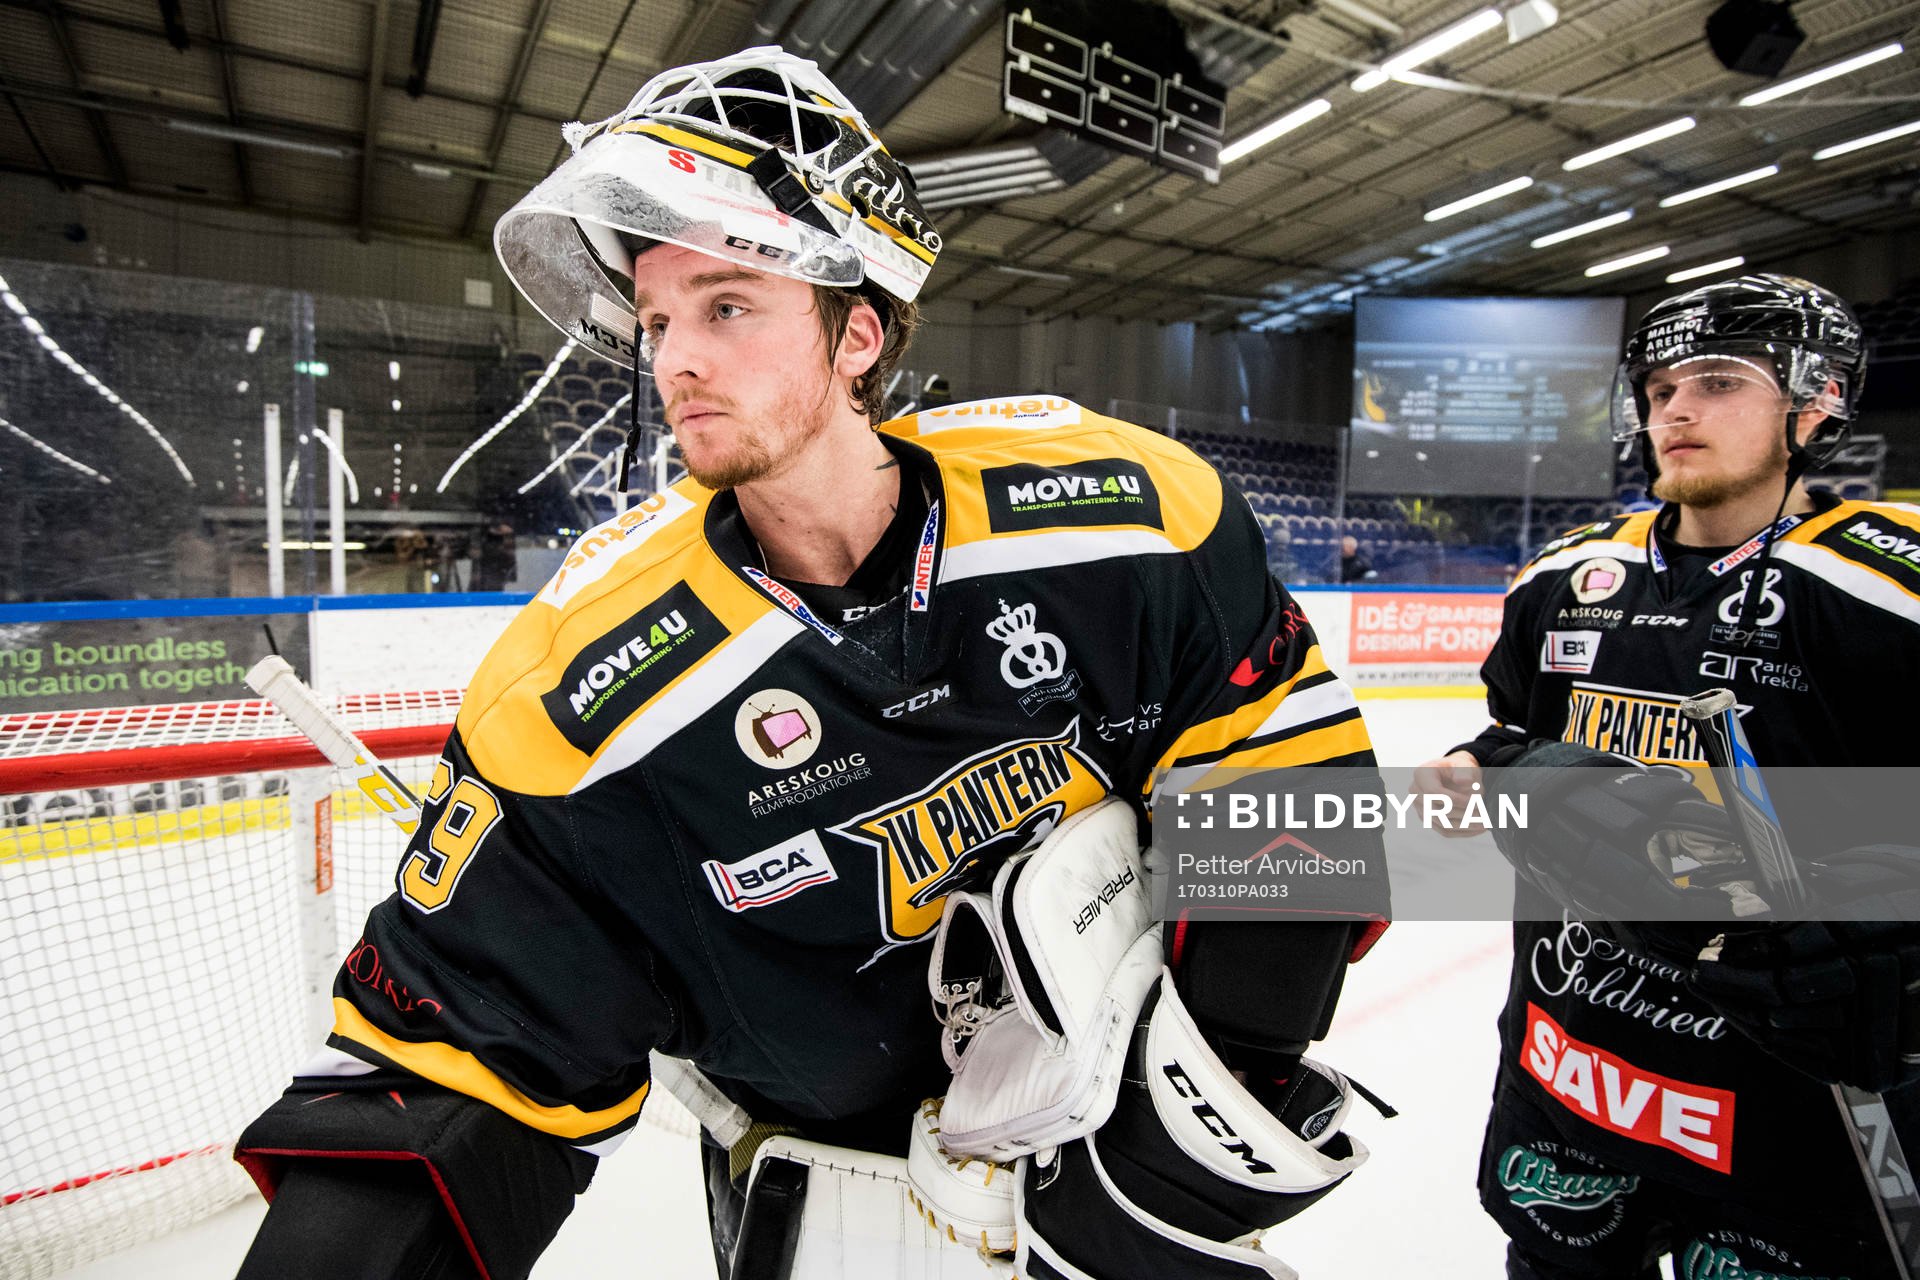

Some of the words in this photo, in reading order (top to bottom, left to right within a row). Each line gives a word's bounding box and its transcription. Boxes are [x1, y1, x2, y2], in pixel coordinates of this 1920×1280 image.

[1645, 332, 1695, 351] ARENA
[1008, 474, 1141, 506] MOVE4U
[1012, 500, 1066, 513] TRANSPORTER
[1071, 496, 1119, 507] MONTERING
[915, 506, 939, 590] INTERSPORT
[758, 577, 839, 640] INTERSPORT
[1356, 601, 1399, 631] IDÉ
[1630, 614, 1689, 628] CCM
[53, 636, 227, 666] boundless
[569, 609, 688, 716] MOVE4U
[1356, 634, 1421, 651] DESIGN
[581, 678, 627, 723] TRANSPORTER
[629, 645, 673, 679] MONTERING
[675, 628, 696, 646] FLYTT
[881, 684, 950, 719] CCM
[748, 752, 867, 807] ARESKOUG
[751, 766, 873, 819] FILMPRODUKTIONER
[876, 808, 941, 886] IK
[923, 742, 1073, 866] PANTERN
[734, 850, 813, 890] BCA
[1072, 865, 1136, 936] PREMIER
[1162, 1058, 1278, 1175] CCM
[1536, 1140, 1559, 1154] EST
[1526, 1207, 1551, 1234] BAR
[1566, 1197, 1626, 1248] RESTAURANT
[1749, 1236, 1790, 1264] 1988
